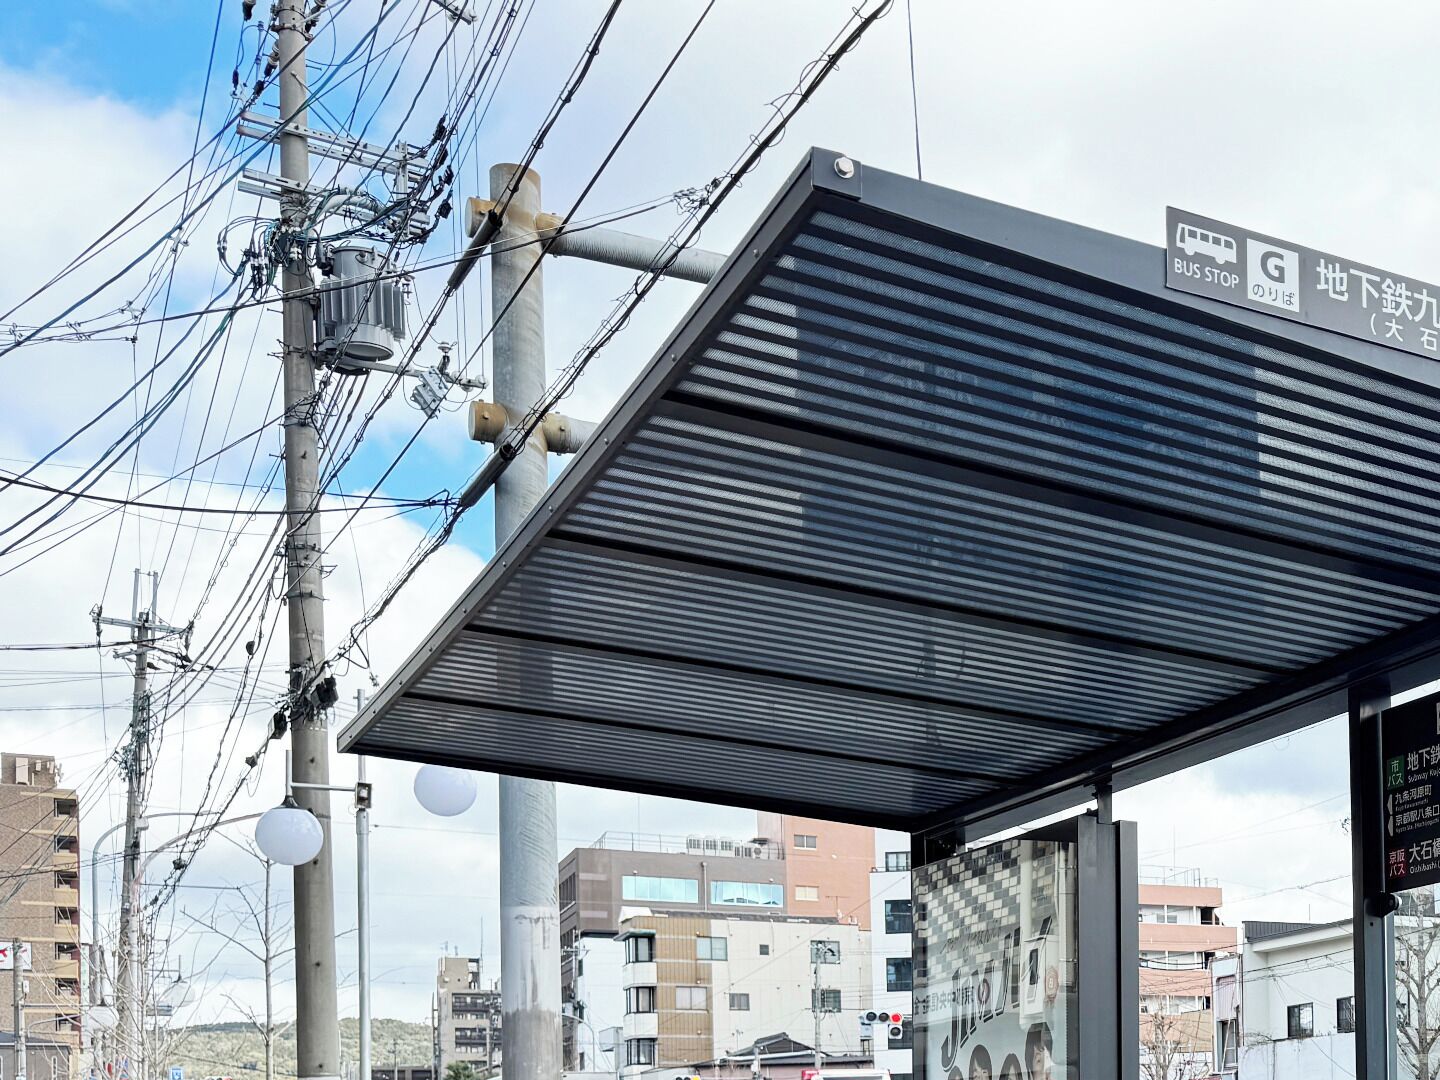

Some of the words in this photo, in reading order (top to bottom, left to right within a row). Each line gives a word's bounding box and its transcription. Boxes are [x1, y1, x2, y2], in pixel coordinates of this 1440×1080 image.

[1174, 258, 1201, 279] BUS
[1205, 267, 1239, 288] STOP
[1260, 251, 1286, 283] G
[1252, 283, 1295, 306] のりば
[1387, 773, 1403, 787] バス
[1407, 771, 1429, 784] Subway
[1395, 784, 1432, 805] 九条河原町
[1389, 848, 1405, 864] 京阪
[1389, 864, 1405, 877] バス
